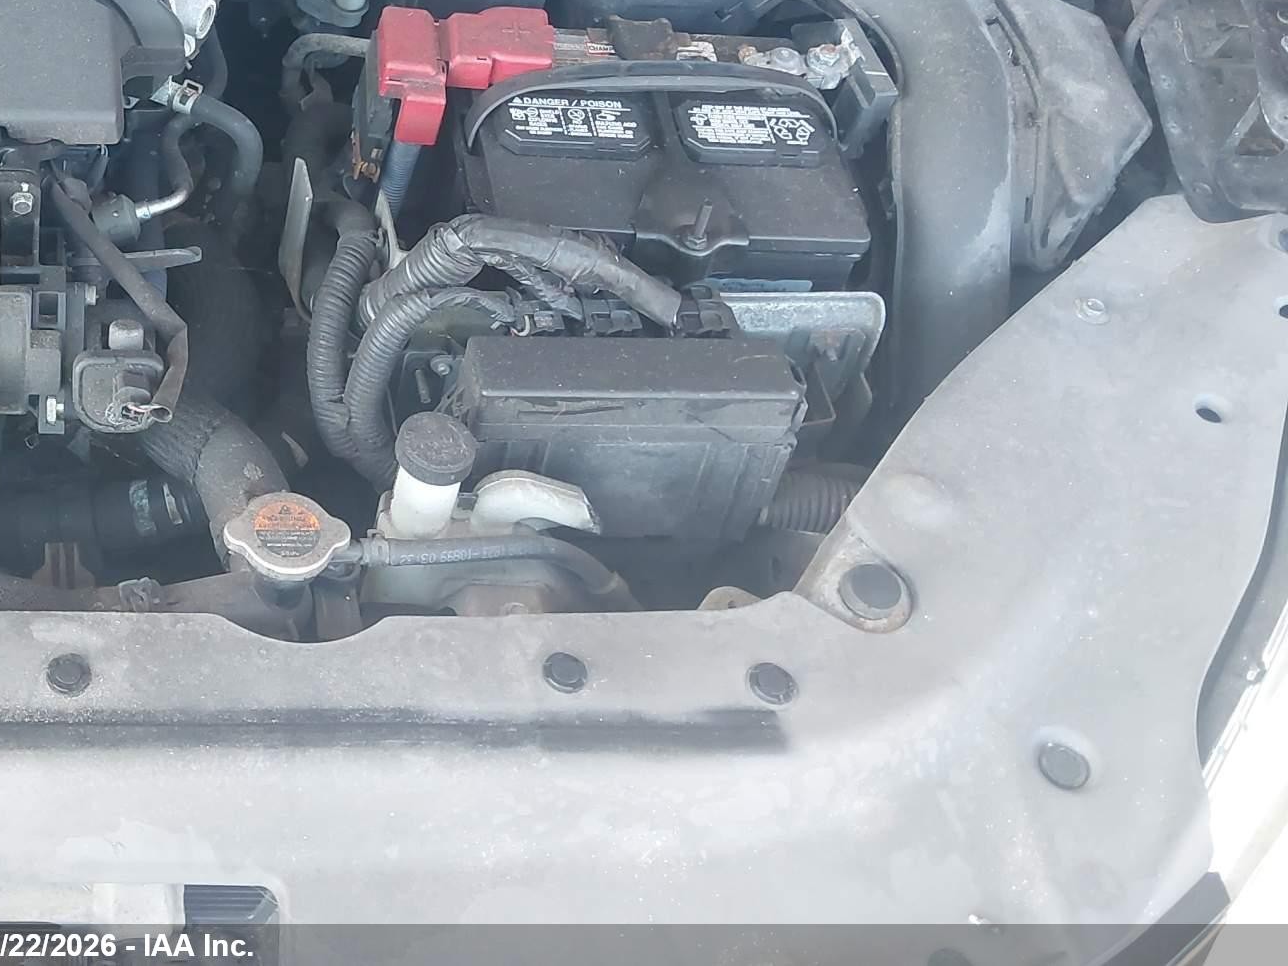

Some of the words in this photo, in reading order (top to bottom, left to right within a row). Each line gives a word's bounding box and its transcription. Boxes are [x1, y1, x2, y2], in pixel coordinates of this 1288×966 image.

[523, 96, 570, 107] DANGER
[571, 99, 579, 107] /
[580, 99, 622, 109] POISON
